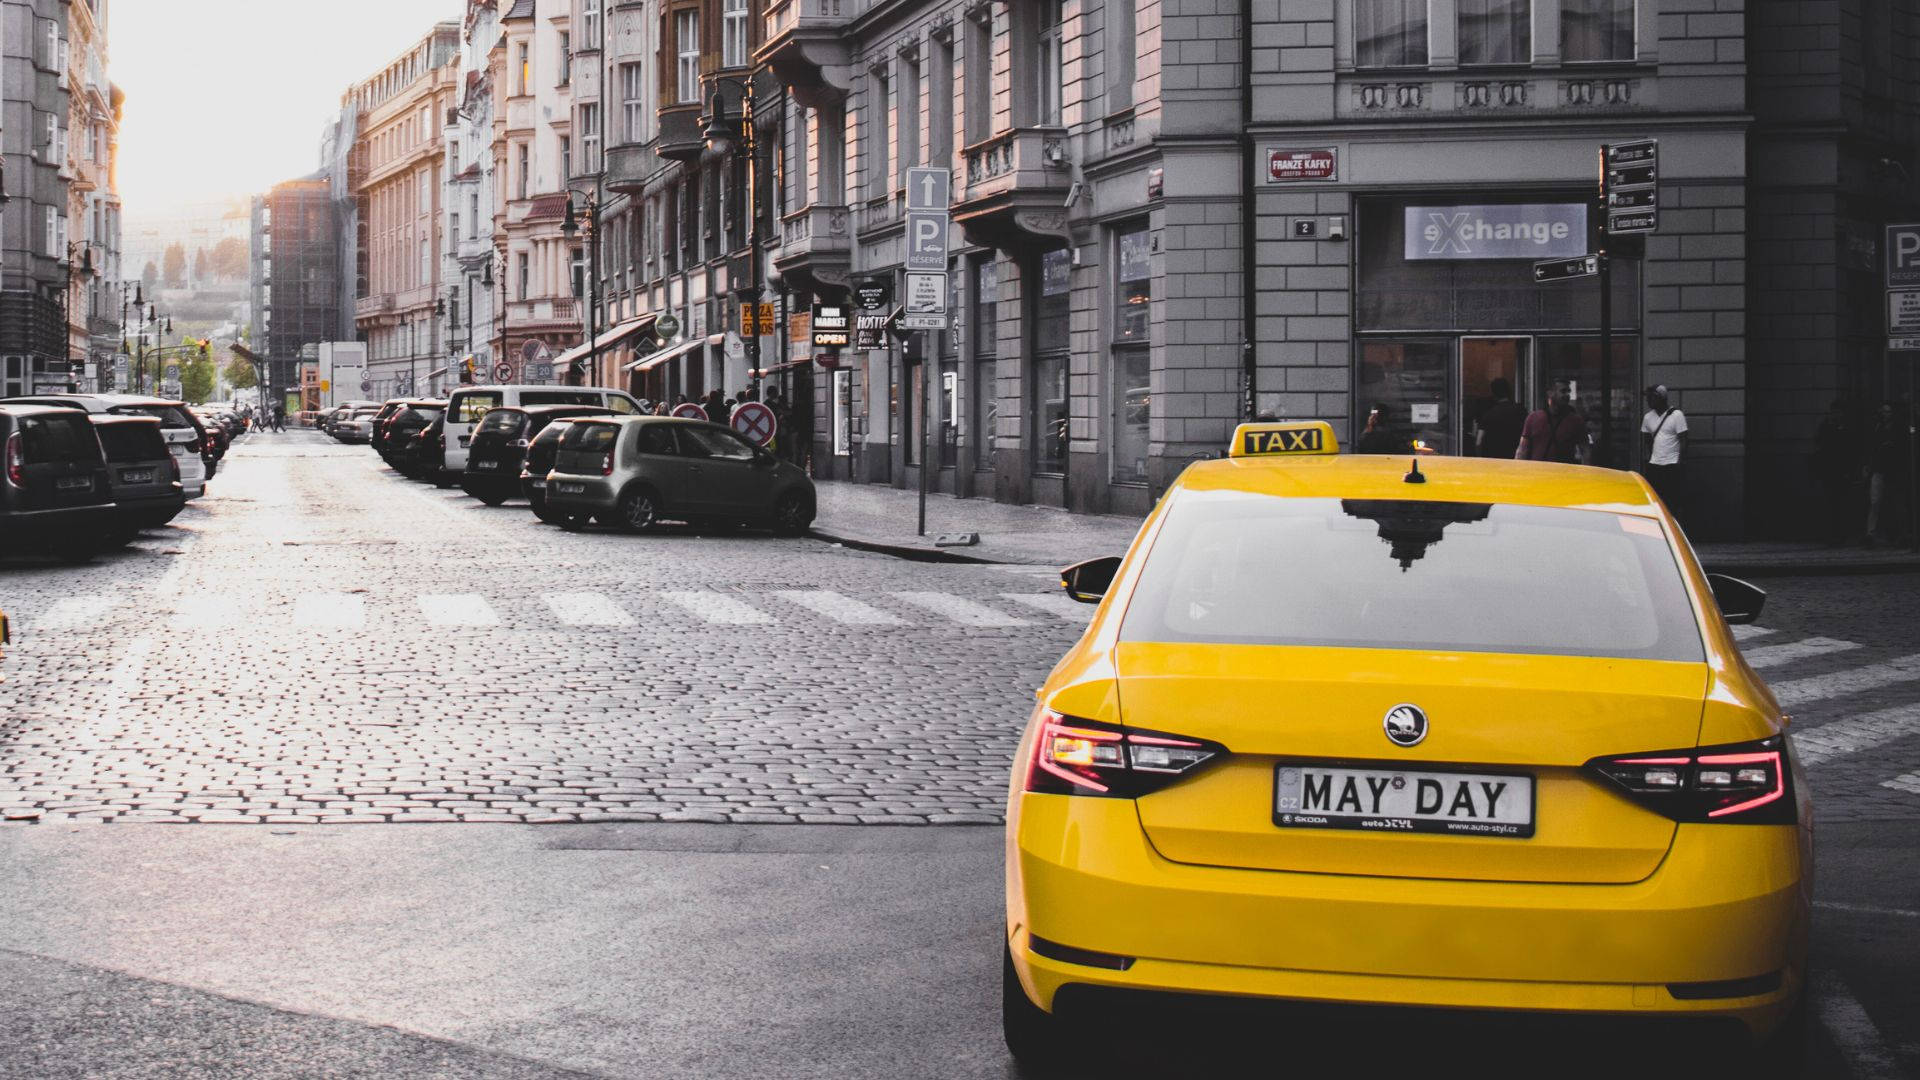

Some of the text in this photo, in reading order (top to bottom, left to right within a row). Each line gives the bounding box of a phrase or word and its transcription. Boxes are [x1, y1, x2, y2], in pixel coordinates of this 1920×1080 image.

[1272, 159, 1331, 169] FRANZE KAFKY
[1302, 223, 1308, 233] 2
[1424, 212, 1569, 254] eXchange
[915, 219, 939, 252] P
[1897, 233, 1920, 268] P
[743, 305, 773, 317] PZA
[743, 322, 774, 335] GOS
[815, 317, 846, 328] MARKET
[815, 334, 846, 344] OPEN
[538, 366, 550, 376] 20
[1247, 430, 1318, 452] TAXI
[1302, 774, 1507, 818] MAY DAY
[1280, 797, 1298, 809] CZ
[1447, 823, 1518, 833] www.auto-styl.cz
